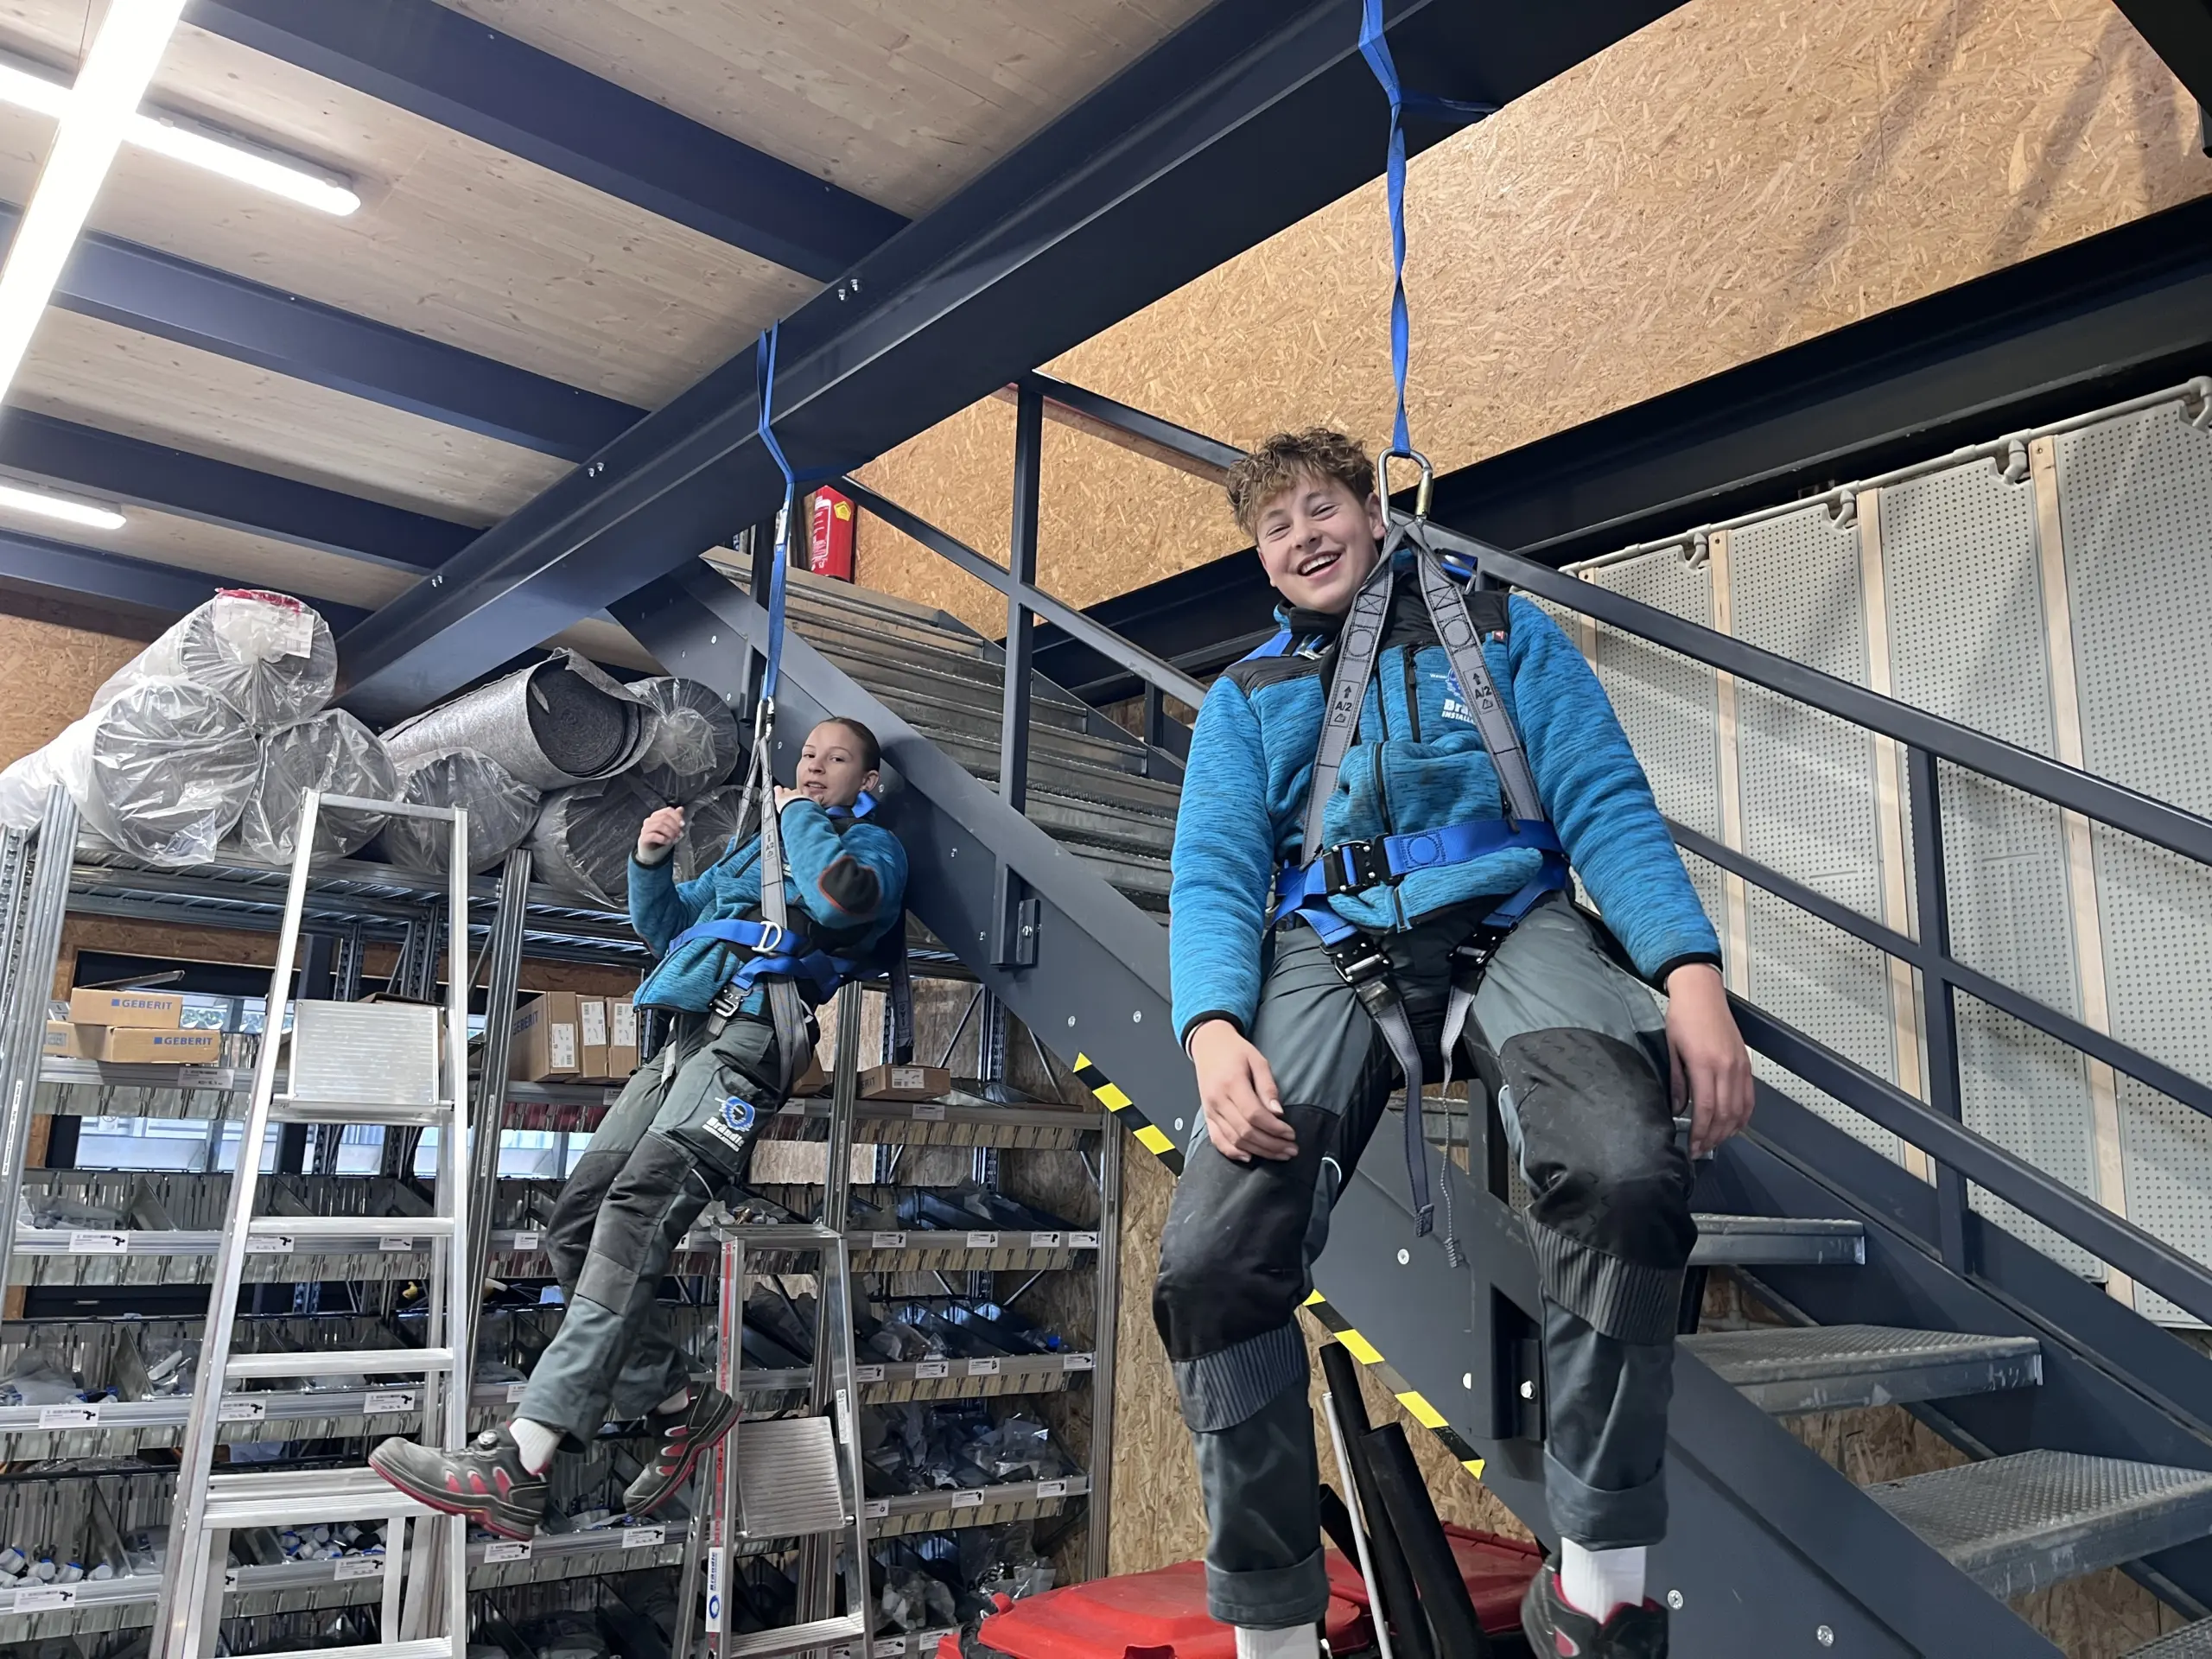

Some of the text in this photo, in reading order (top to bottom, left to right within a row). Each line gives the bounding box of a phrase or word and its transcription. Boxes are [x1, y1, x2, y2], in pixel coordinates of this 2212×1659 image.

[1475, 686, 1492, 700] A/2
[1335, 701, 1352, 712] A/2
[122, 999, 173, 1010] GEBERIT
[164, 1037, 213, 1046] GEBERIT
